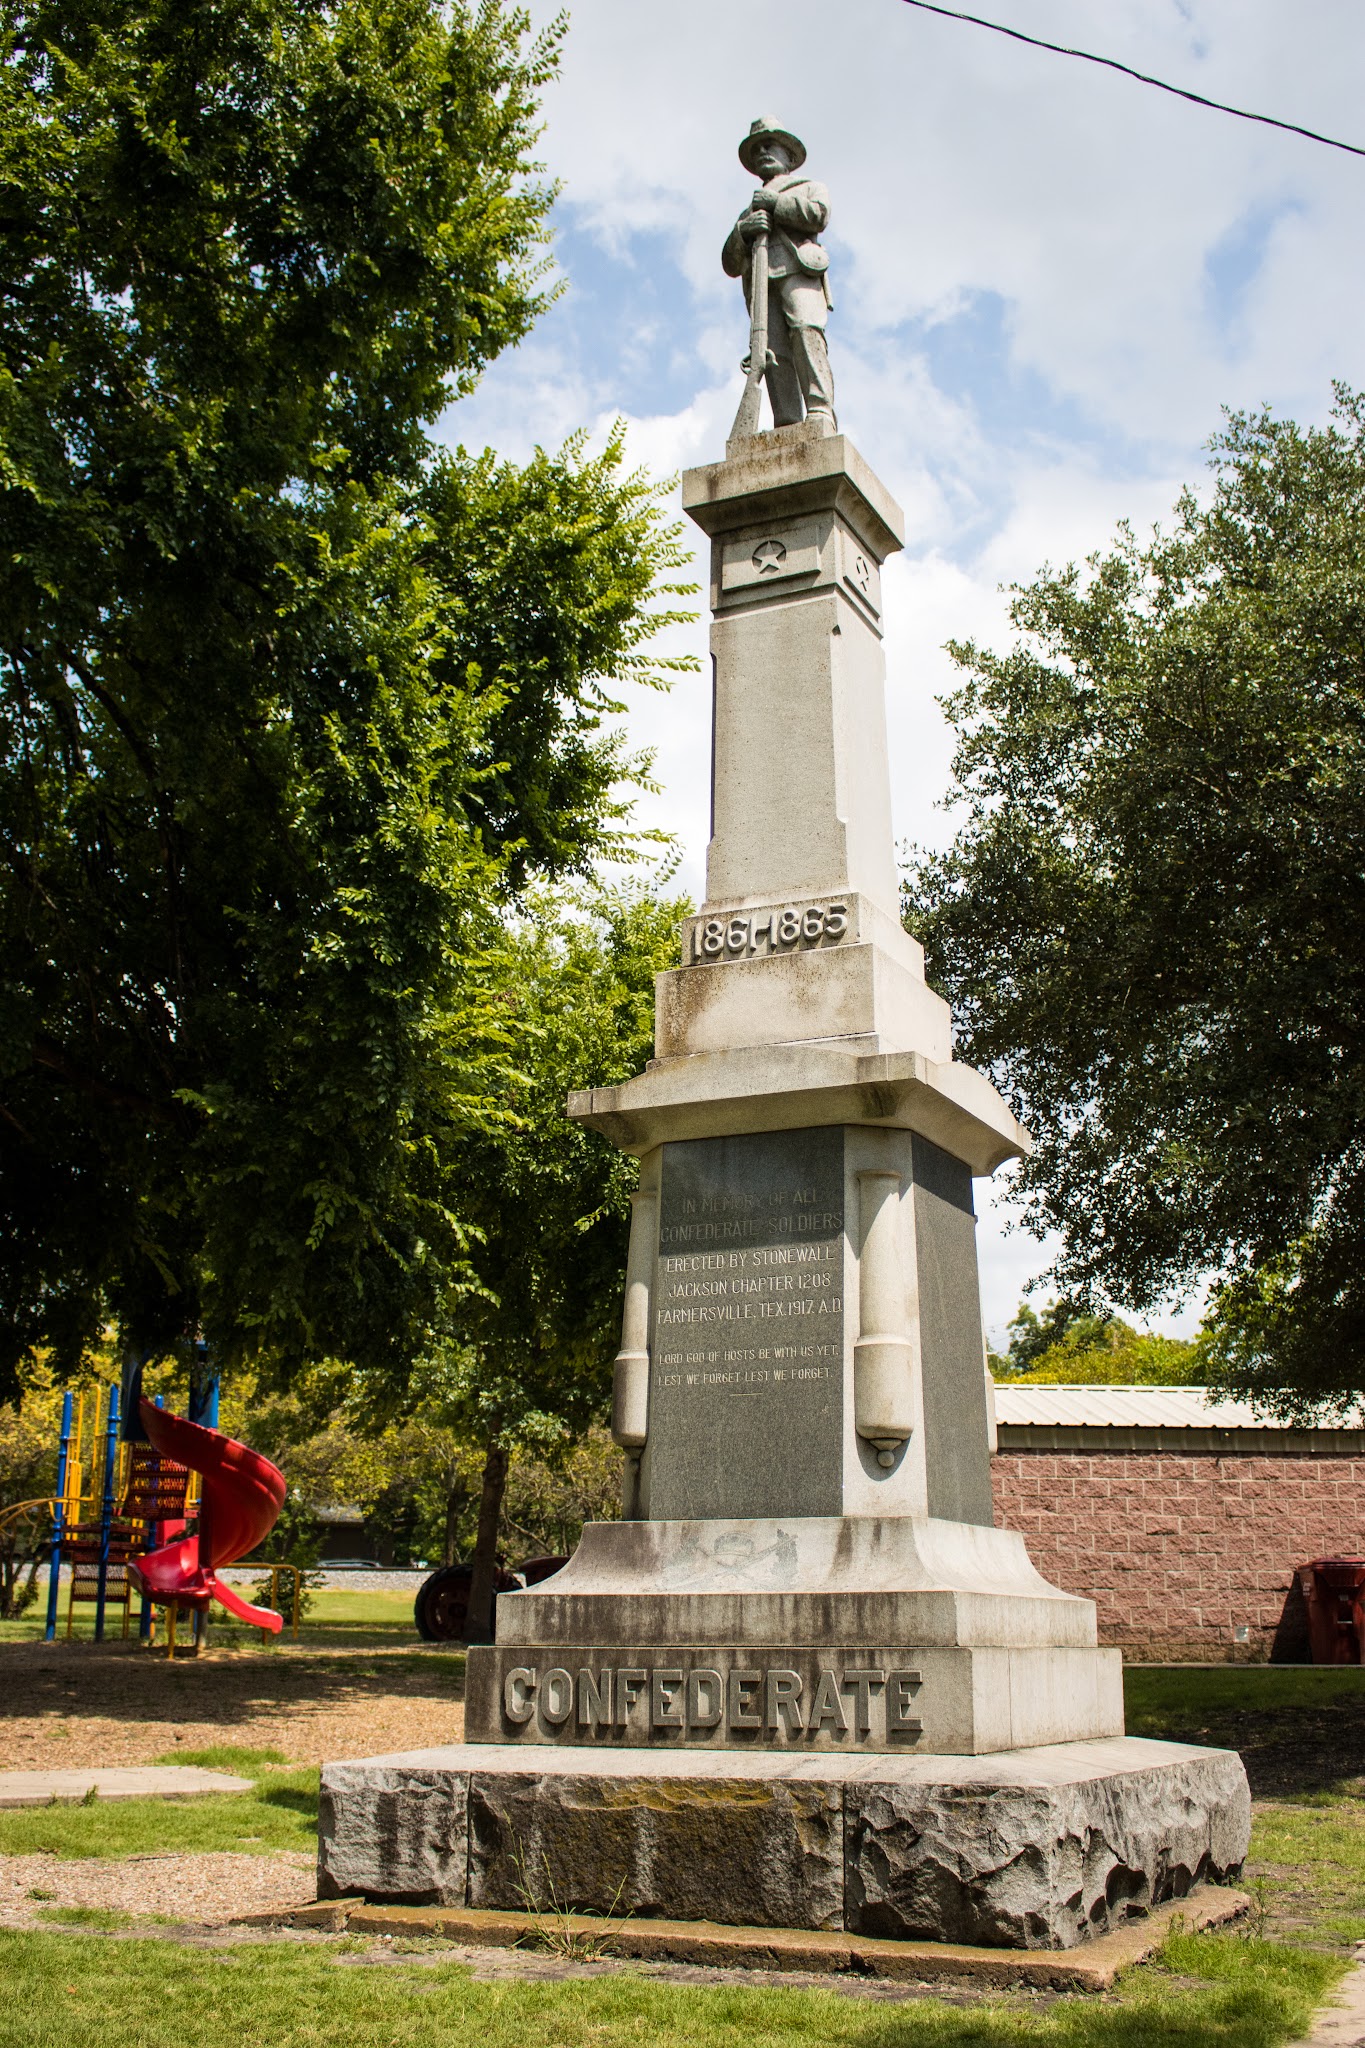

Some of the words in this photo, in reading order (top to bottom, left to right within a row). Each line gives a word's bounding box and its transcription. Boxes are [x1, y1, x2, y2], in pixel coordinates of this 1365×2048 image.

[682, 1198, 696, 1214] IN
[701, 1193, 763, 1212] MEMORY
[769, 1191, 788, 1206] OF
[793, 1187, 822, 1205] ALL
[660, 1219, 759, 1243] CONFEDERATE
[768, 1212, 843, 1234] SOLDIERS
[667, 1253, 724, 1273] ERECTED
[729, 1252, 747, 1268] BY
[753, 1246, 835, 1266] STONEWALL
[668, 1280, 728, 1298] JACKSON
[732, 1275, 793, 1294] CHAPTER
[798, 1272, 831, 1289] 1208
[659, 1353, 683, 1365] LORD
[686, 1352, 705, 1363] GOD
[708, 1351, 721, 1362] OF
[724, 1349, 755, 1361] HOSTS
[759, 1348, 771, 1359] BE
[773, 1347, 797, 1359] WITH
[801, 1345, 814, 1357] US
[658, 1375, 682, 1386] LEST
[686, 1374, 700, 1385] WE
[703, 1372, 740, 1385] FORGET
[745, 1370, 769, 1382] LEST
[773, 1369, 788, 1381] WE
[504, 1667, 924, 1732] CONFEDERATE
